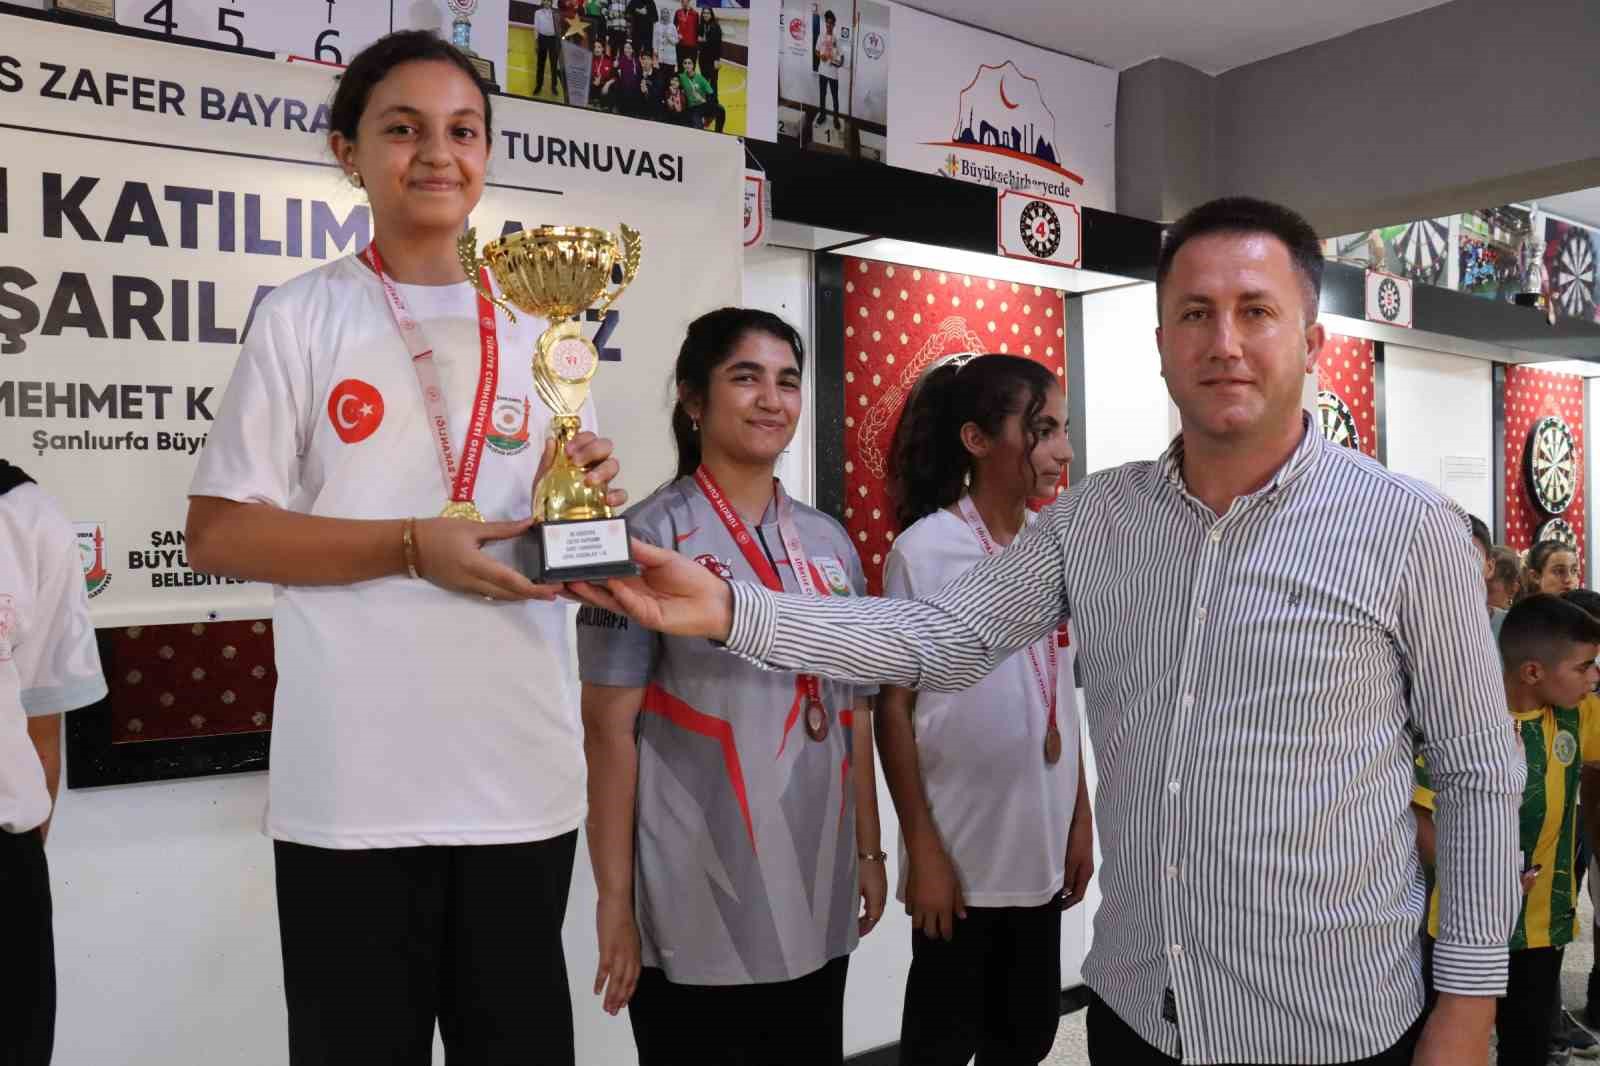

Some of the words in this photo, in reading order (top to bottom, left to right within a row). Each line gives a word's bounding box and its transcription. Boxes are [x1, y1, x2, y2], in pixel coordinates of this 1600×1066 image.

[144, 0, 178, 35] 4
[218, 8, 245, 47] 5
[314, 29, 342, 64] 6
[39, 62, 186, 117] ZAFER
[200, 86, 332, 134] BAYRA
[501, 130, 683, 183] TURNUVASI
[42, 171, 370, 260] KATILIM
[1035, 221, 1046, 239] 4
[32, 429, 149, 456] Şanlıurfa
